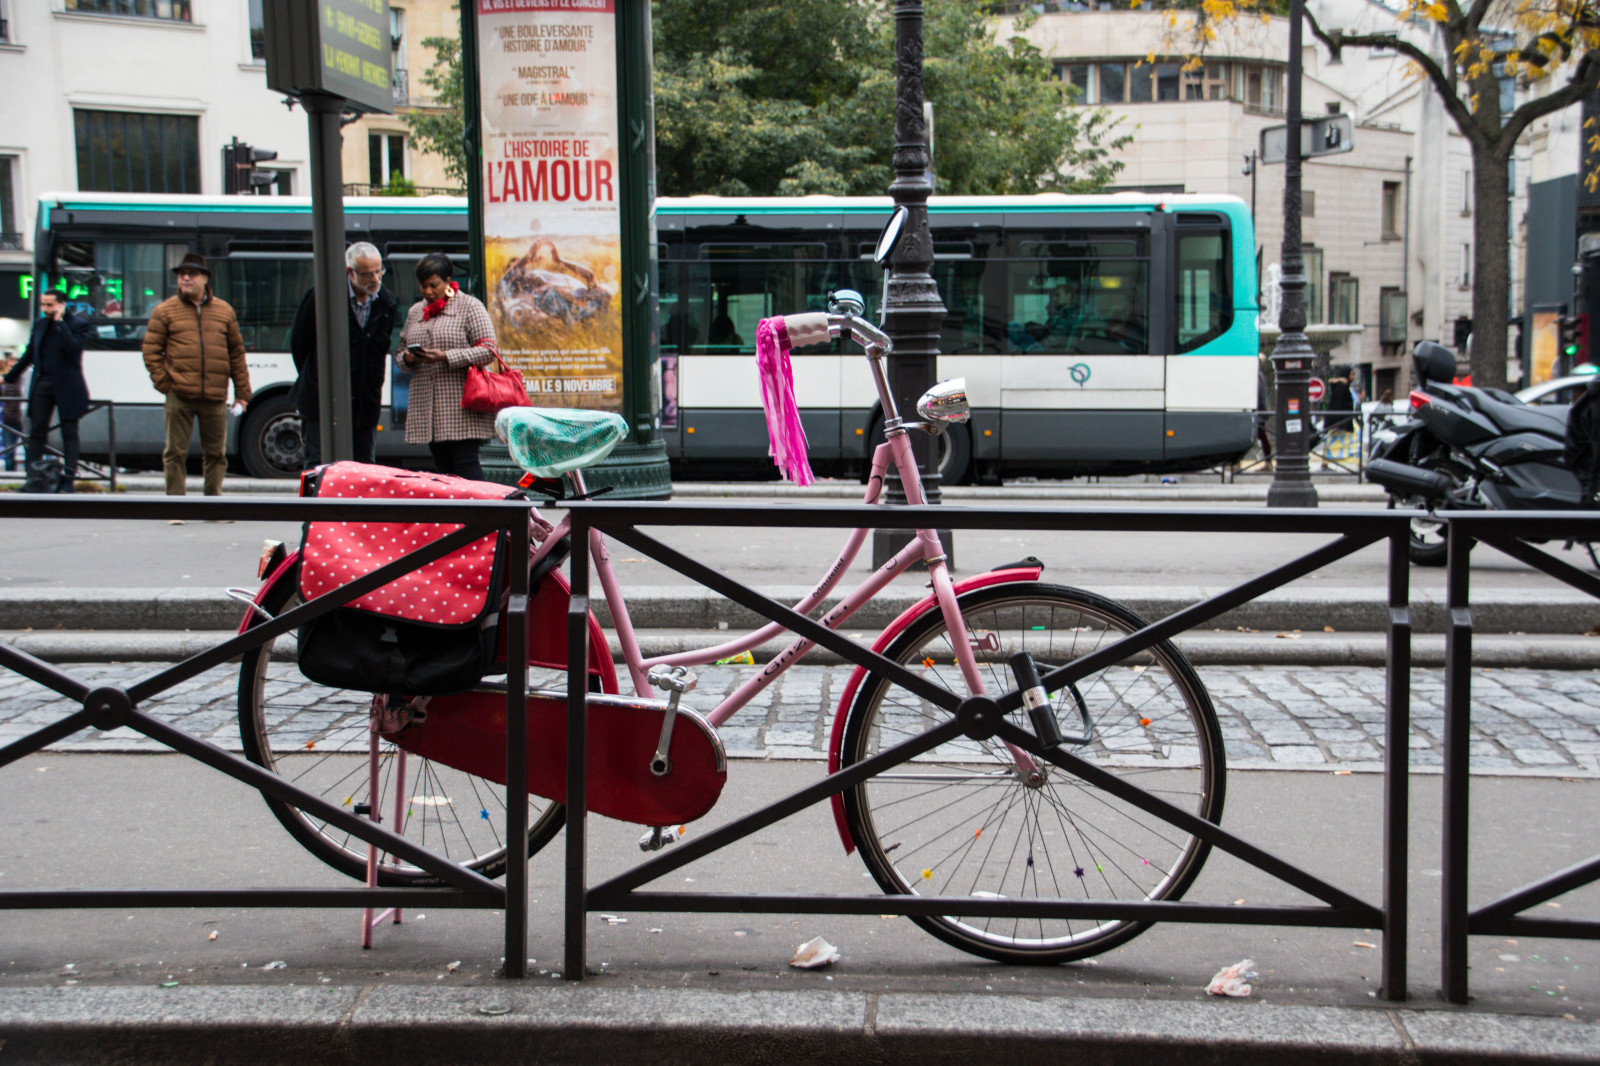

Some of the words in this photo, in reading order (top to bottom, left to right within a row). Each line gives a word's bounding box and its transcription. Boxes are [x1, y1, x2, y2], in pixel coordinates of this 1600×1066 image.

[517, 25, 594, 38] BOULEVERSANTE
[503, 40, 542, 53] HISTOIRE
[521, 94, 539, 106] ODE
[504, 140, 569, 158] L'HISTOIRE
[573, 140, 590, 158] DE
[488, 159, 613, 203] L'AMOUR
[542, 379, 554, 392] LE
[555, 379, 562, 392] 9
[563, 379, 614, 392] NOVEMBRE
